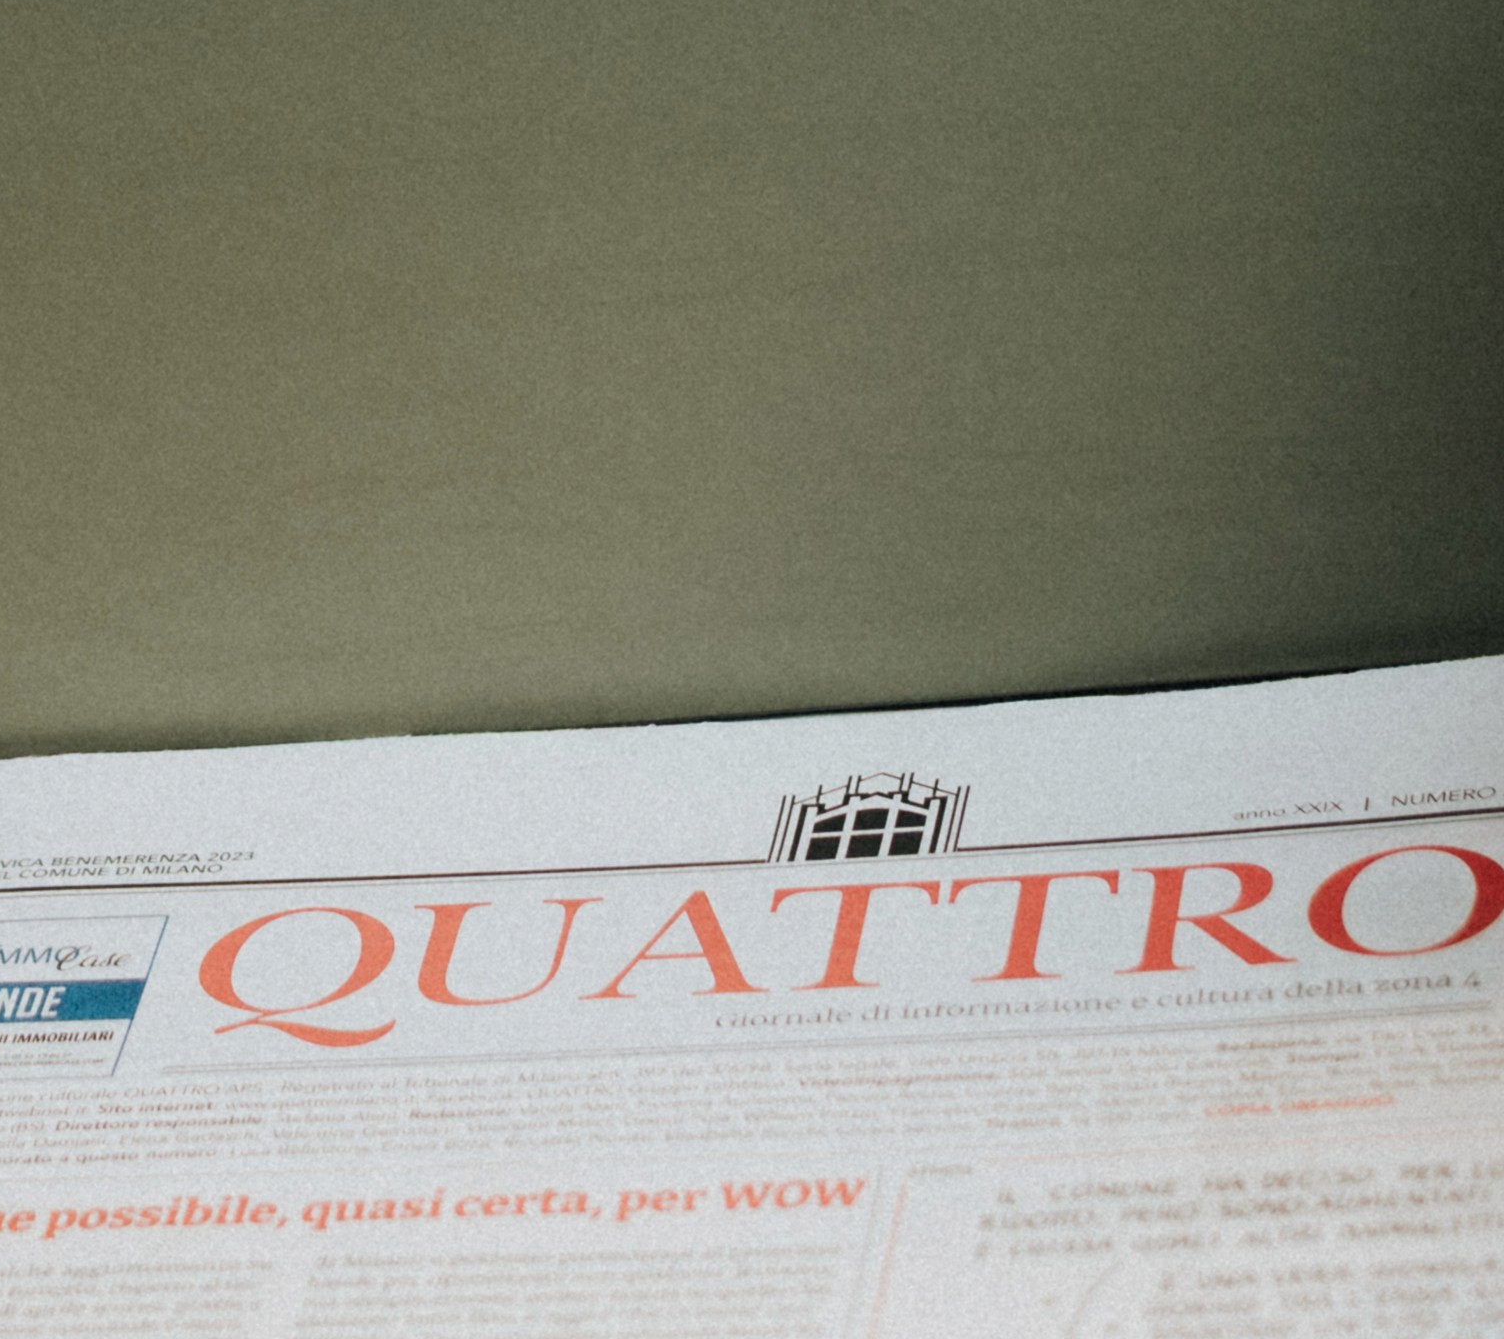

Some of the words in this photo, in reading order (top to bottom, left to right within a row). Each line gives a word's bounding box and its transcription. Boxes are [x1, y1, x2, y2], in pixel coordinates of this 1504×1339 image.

[1233, 807, 1286, 822] anno
[1291, 800, 1344, 817] XXIX
[1391, 785, 1498, 810] NUMERO
[19, 866, 109, 880] COMUNE
[114, 866, 139, 878] DI
[143, 863, 224, 876] MILANO
[50, 853, 201, 867] BENEMERENZA
[207, 850, 257, 863] 2023
[56, 944, 134, 972] Case
[714, 1006, 853, 1029] Giornale
[862, 1003, 891, 1023] di
[900, 996, 1124, 1022] informazione
[1128, 997, 1148, 1011] e
[1155, 987, 1275, 1010] cultura
[1283, 978, 1366, 1000] della
[1372, 973, 1454, 993] zona
[1462, 969, 1483, 990] 4
[11, 1030, 116, 1045] IMMOBILIARI
[40, 1194, 289, 1241] possibile,
[300, 1185, 448, 1232] quasi
[454, 1187, 602, 1221] certa,
[613, 1186, 709, 1225] per
[721, 1176, 869, 1211] WOW
